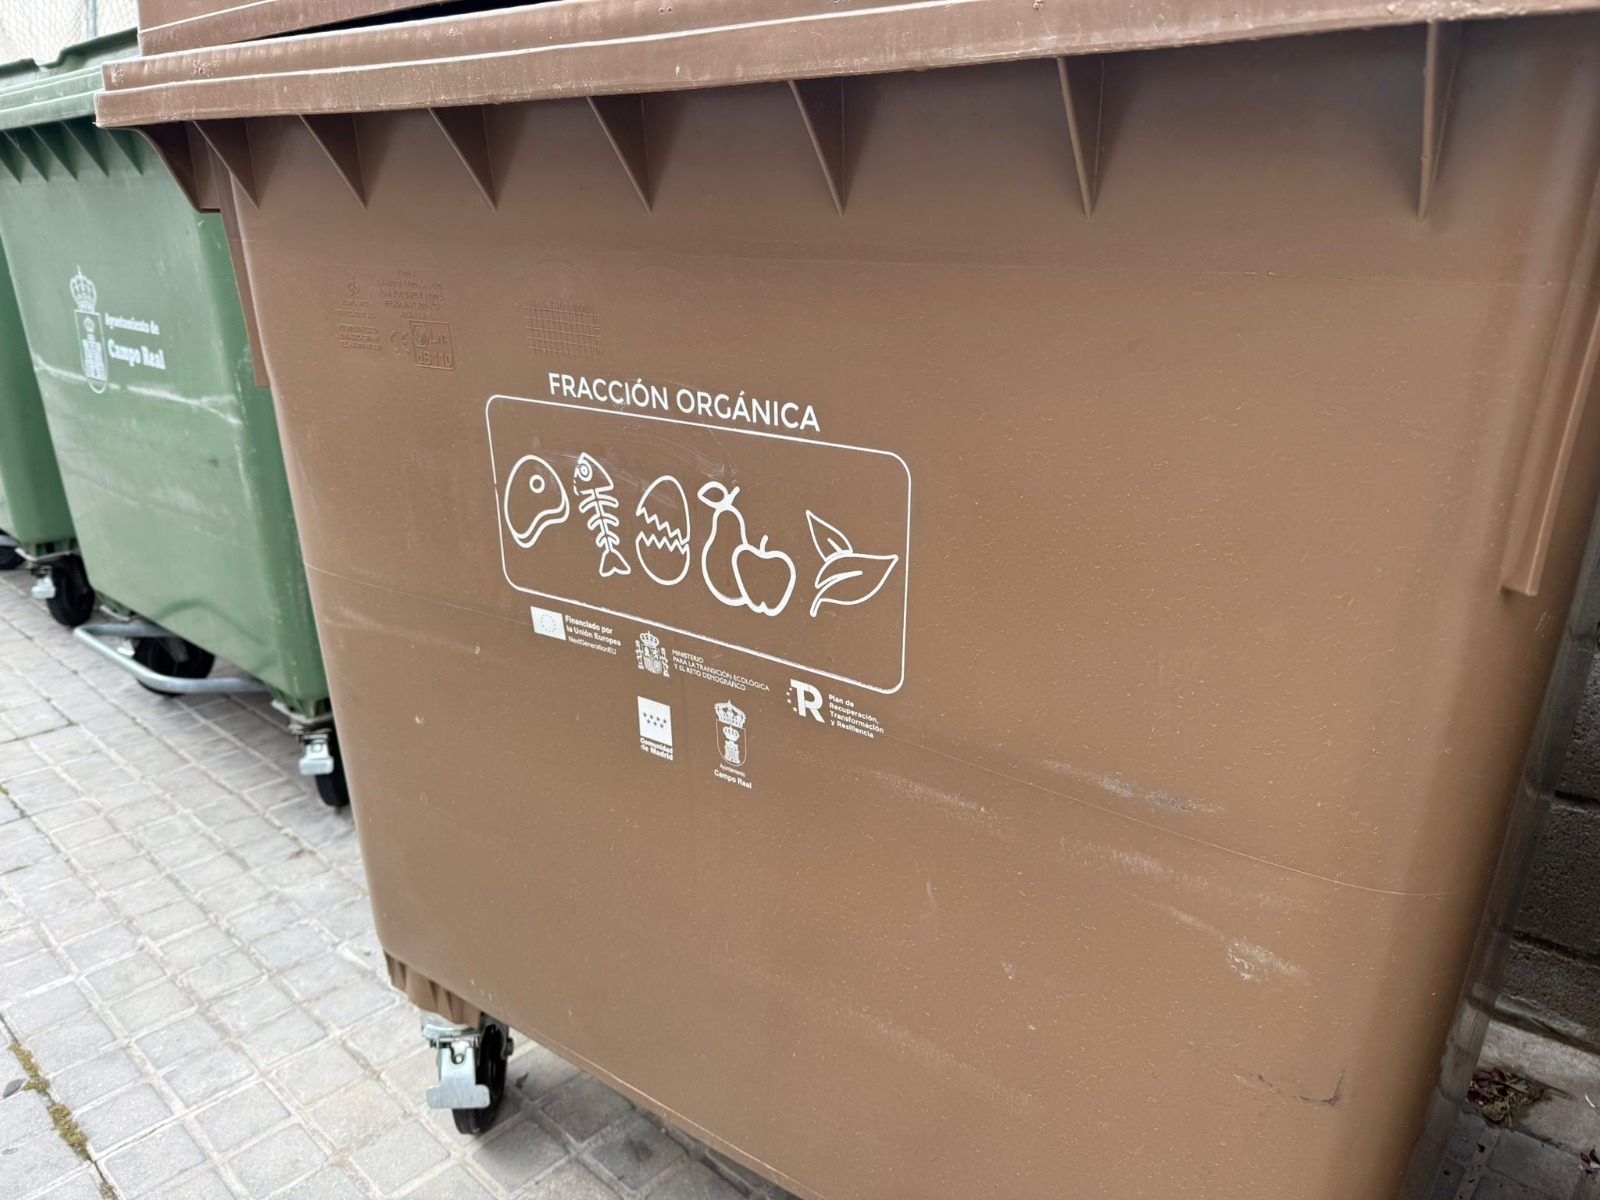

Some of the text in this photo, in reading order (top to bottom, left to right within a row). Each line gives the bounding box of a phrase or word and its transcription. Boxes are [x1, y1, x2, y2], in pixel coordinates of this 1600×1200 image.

[108, 338, 166, 370] Campo Real
[548, 372, 821, 432] FRACCIÓN ORGÁNICA
[565, 615, 613, 635] Financiado por
[566, 625, 622, 647] la Unión Europea
[568, 635, 617, 655] NextGenerationEU
[672, 649, 704, 664] MINISTERIO
[672, 656, 770, 692] PARA LA TRANSICIÓN ECOLÓGICA
[679, 664, 686, 672] EL
[686, 666, 702, 677] RETO
[701, 669, 746, 691] DEMOGRÁFICO
[828, 693, 854, 708] Plan de
[829, 702, 879, 724] Recuperación,
[829, 710, 884, 734] Transformación
[830, 719, 874, 738] y Resiliencia
[714, 769, 752, 789] Campo Real
